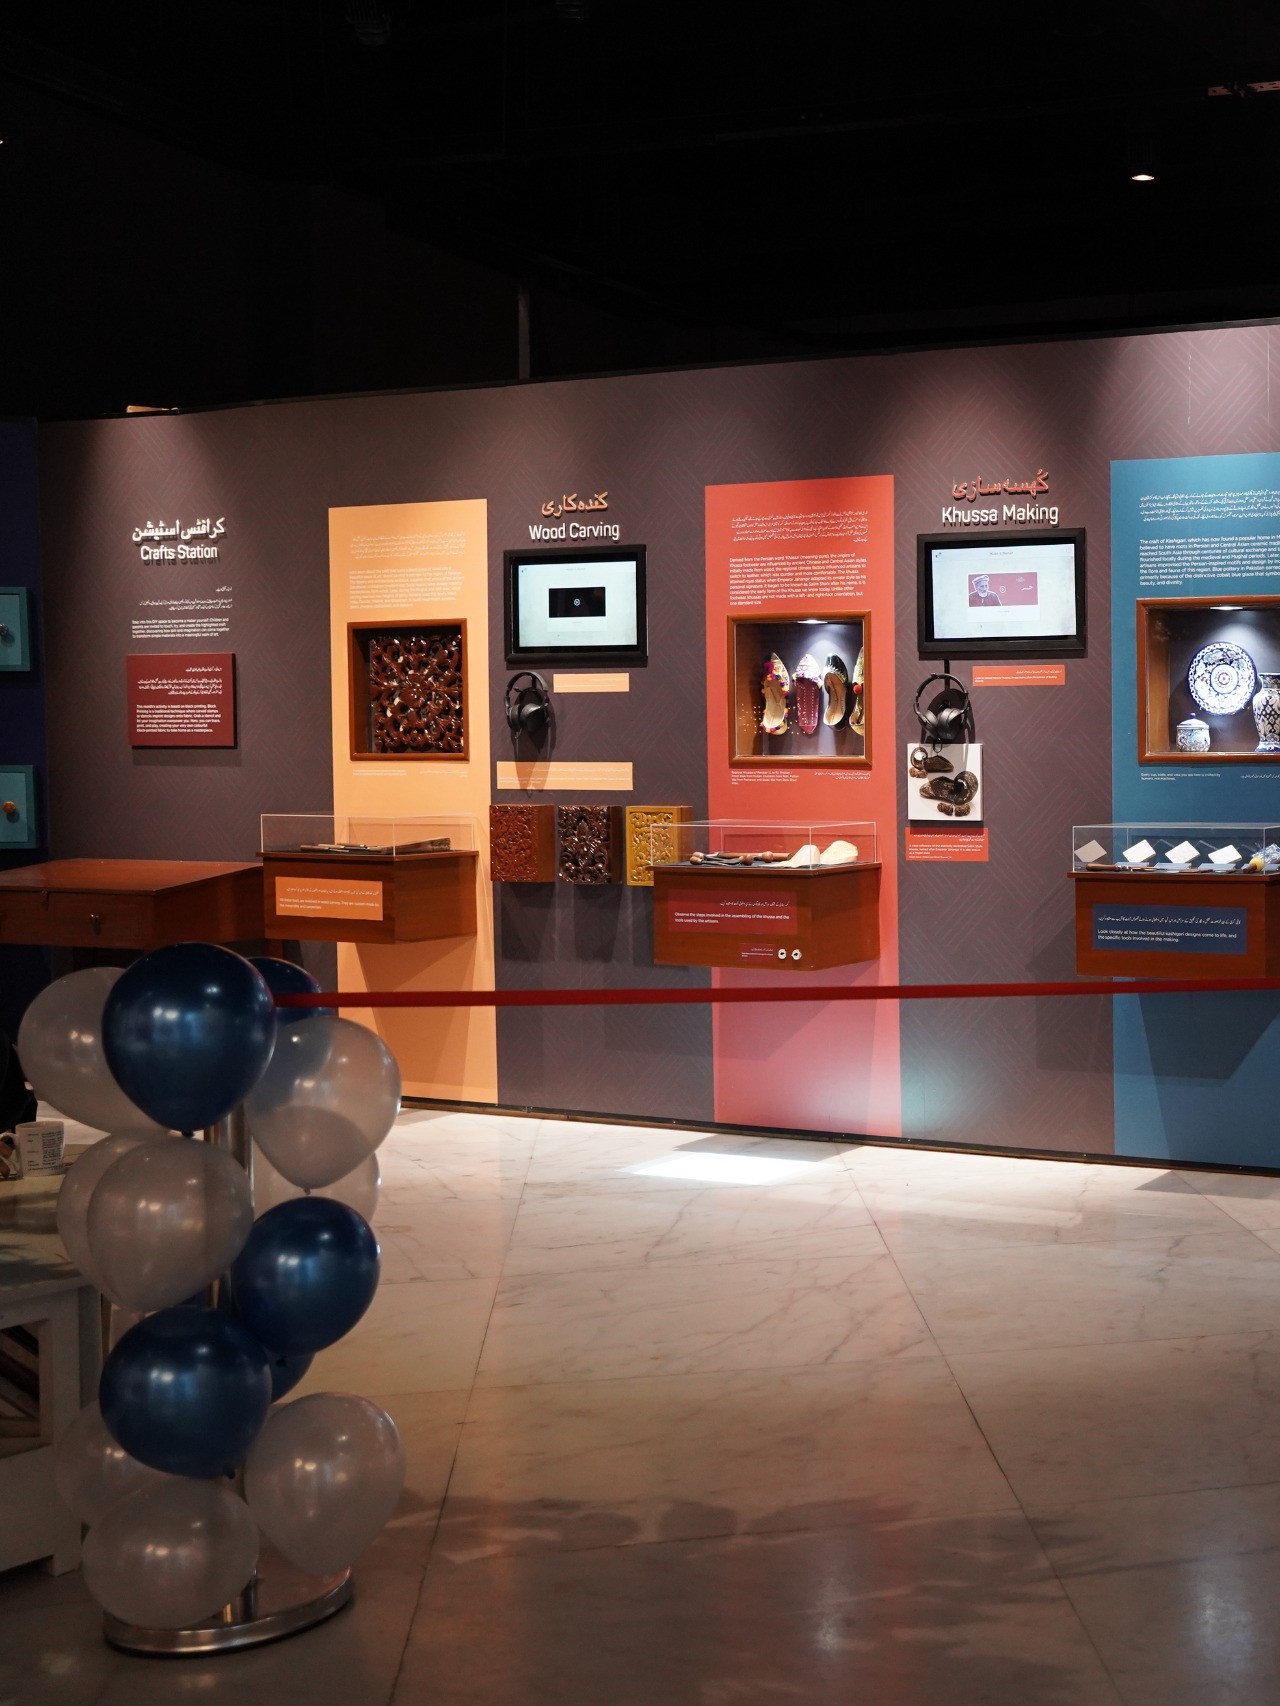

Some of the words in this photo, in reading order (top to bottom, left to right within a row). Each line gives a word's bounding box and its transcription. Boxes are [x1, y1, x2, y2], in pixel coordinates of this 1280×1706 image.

[942, 506, 998, 523] Khussa
[1003, 503, 1059, 524] Making
[529, 523, 566, 540] Wood
[569, 522, 620, 541] Carving
[140, 545, 175, 560] Crafts
[177, 544, 217, 559] Station
